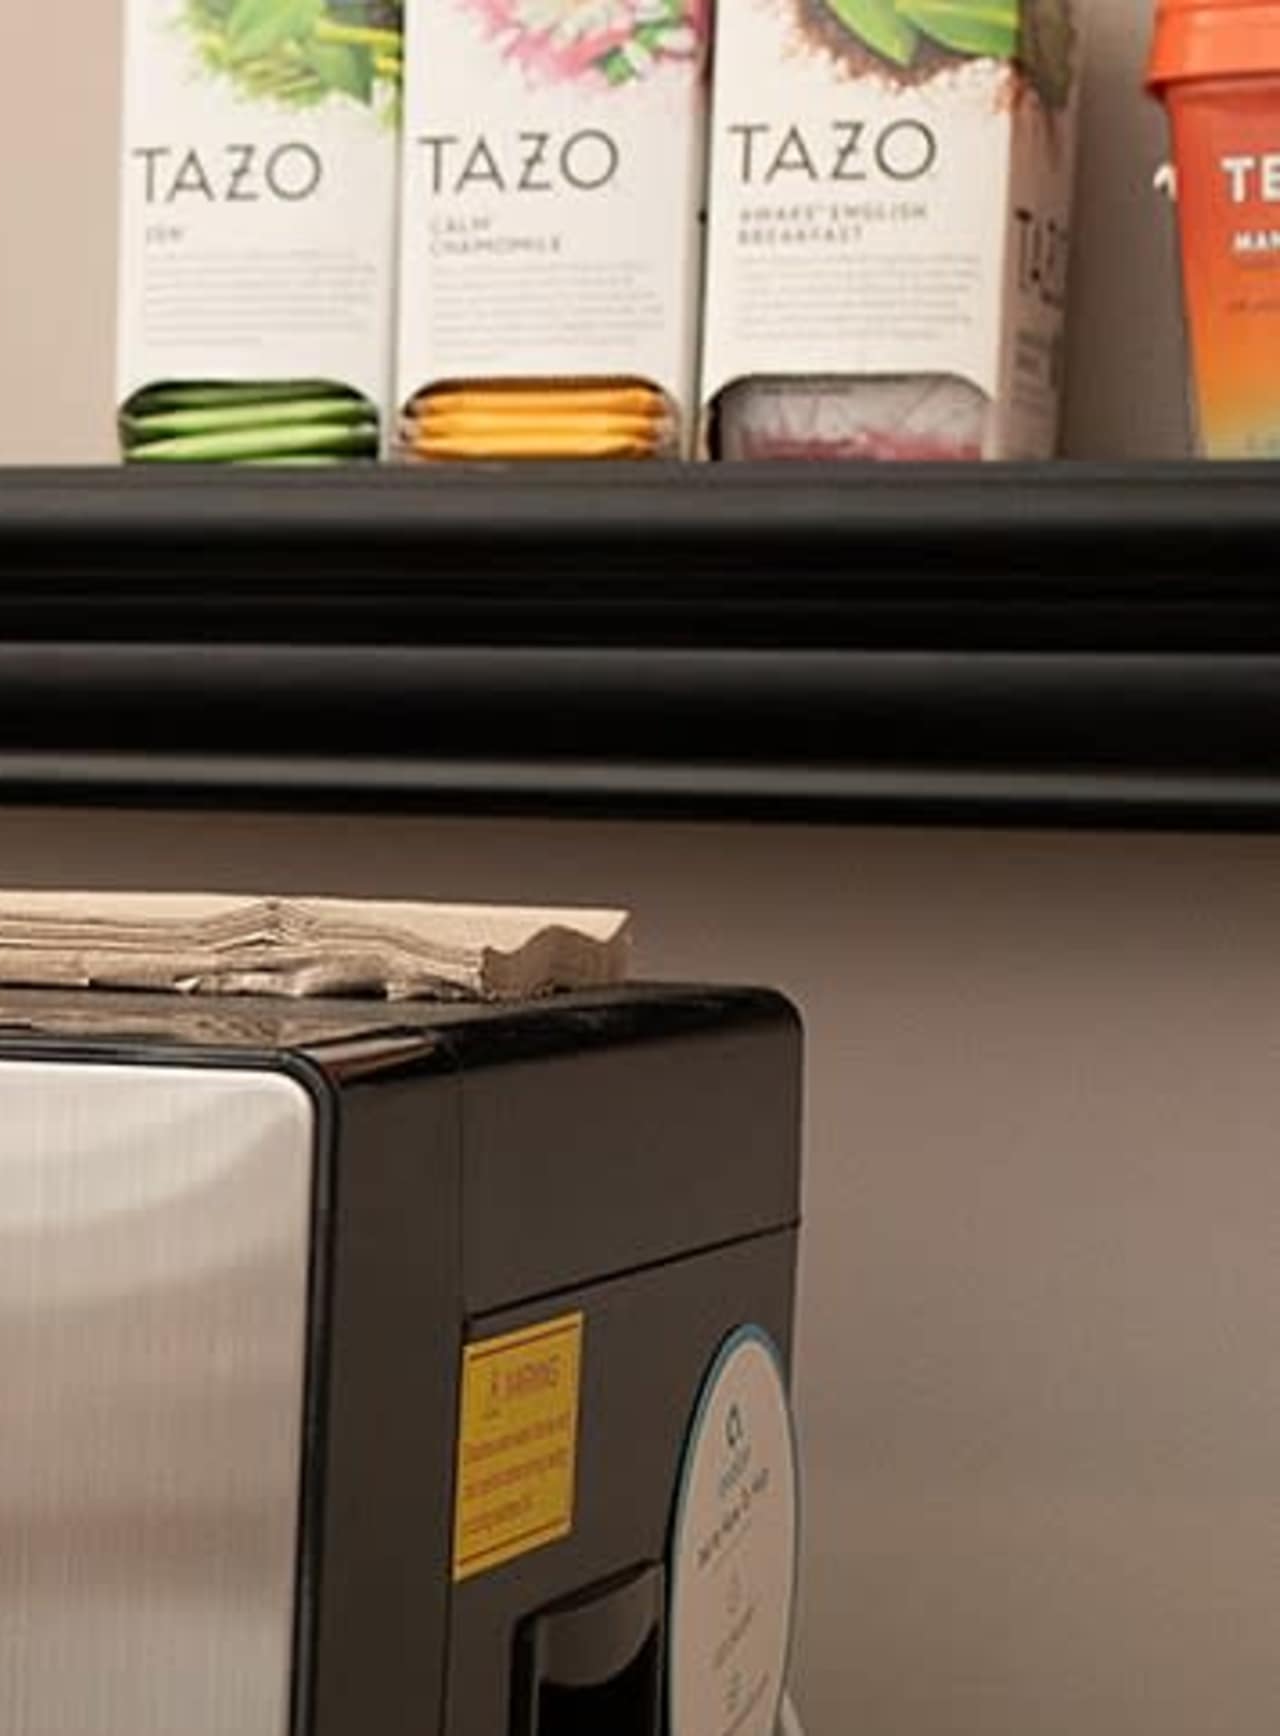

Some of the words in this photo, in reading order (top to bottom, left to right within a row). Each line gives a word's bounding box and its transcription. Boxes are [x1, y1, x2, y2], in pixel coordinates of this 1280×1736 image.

[132, 142, 323, 203] TAZO
[416, 129, 620, 194] TAZO
[727, 118, 937, 184] TAZO
